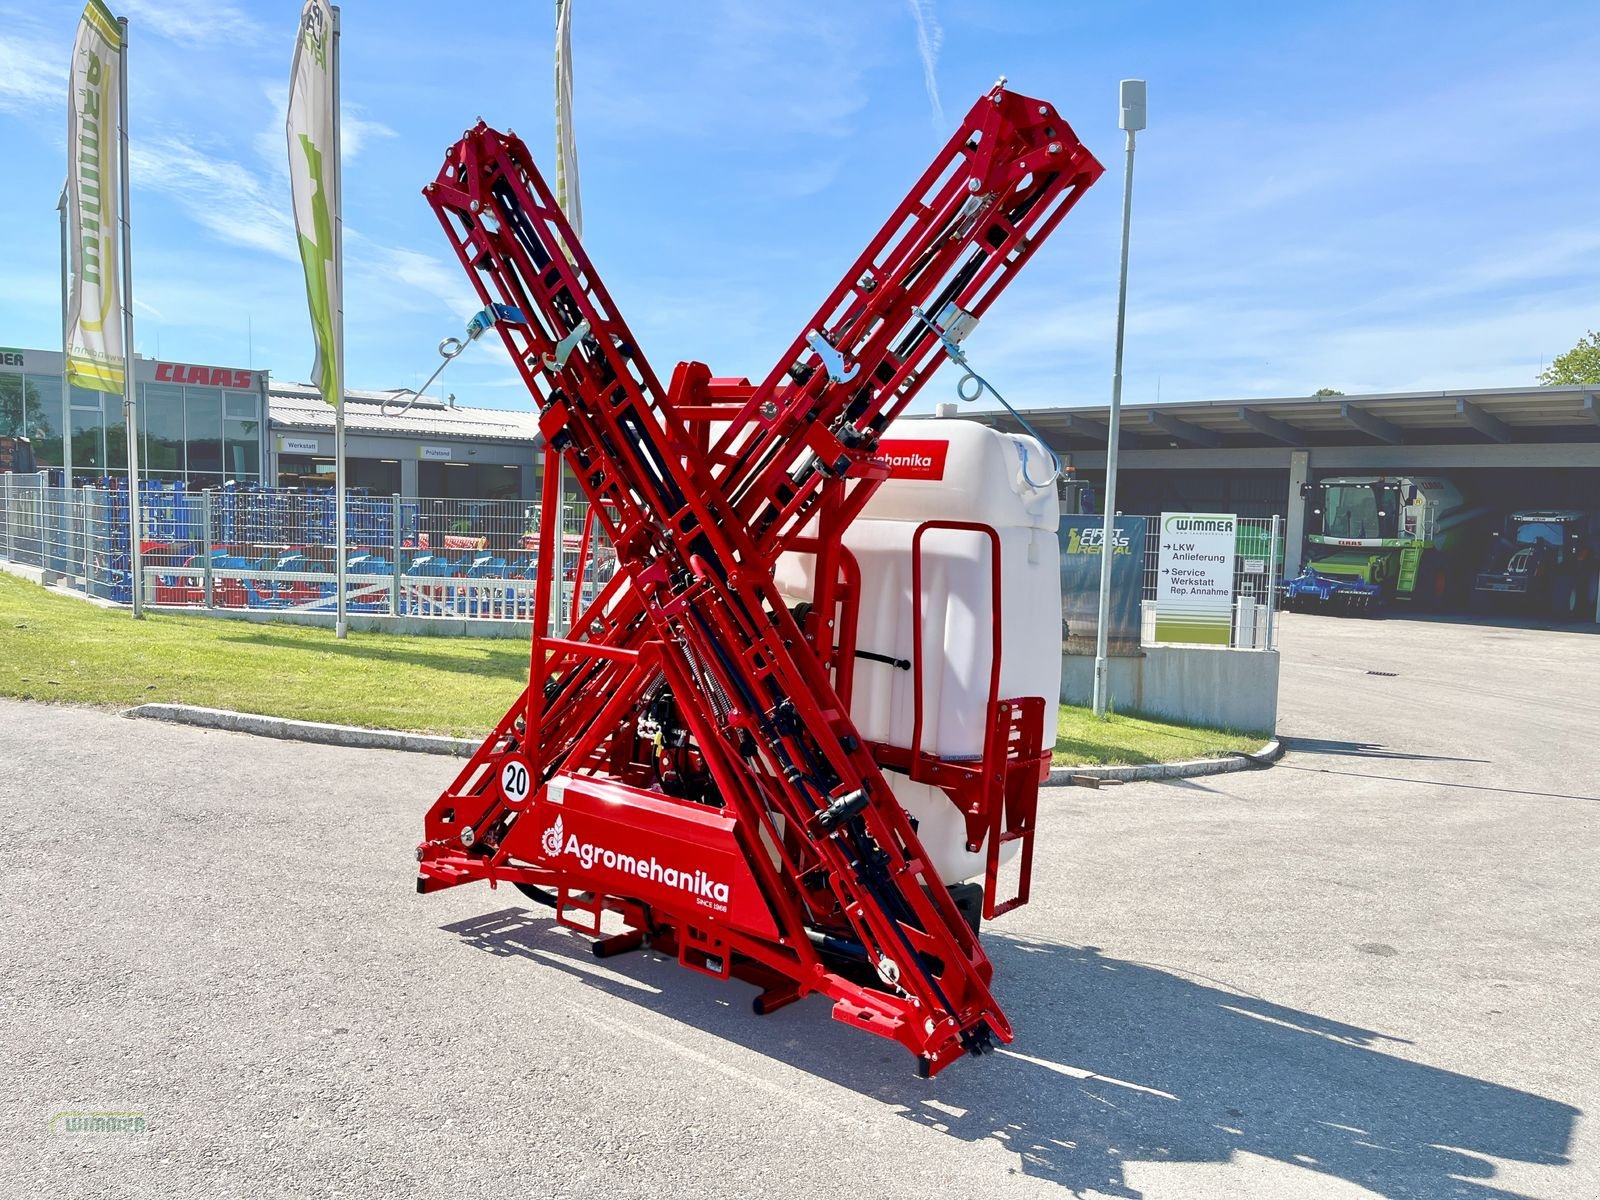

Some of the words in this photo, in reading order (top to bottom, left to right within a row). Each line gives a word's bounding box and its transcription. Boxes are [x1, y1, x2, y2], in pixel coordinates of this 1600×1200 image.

[0, 352, 24, 366] ER
[155, 363, 252, 389] CLAAS
[287, 441, 316, 449] Werkstatt
[425, 449, 450, 457] Prüfstand
[1176, 519, 1233, 532] WIMMER
[1081, 528, 1125, 538] FIRT
[1172, 543, 1195, 551] LKW
[1172, 552, 1226, 564] Anlieferung
[1171, 567, 1206, 577] Service
[1170, 577, 1215, 587] Werkstatt
[1170, 586, 1188, 596] Rep.
[1190, 587, 1229, 596] Annahme
[504, 764, 526, 796] 20
[563, 833, 729, 903] Agromehanika
